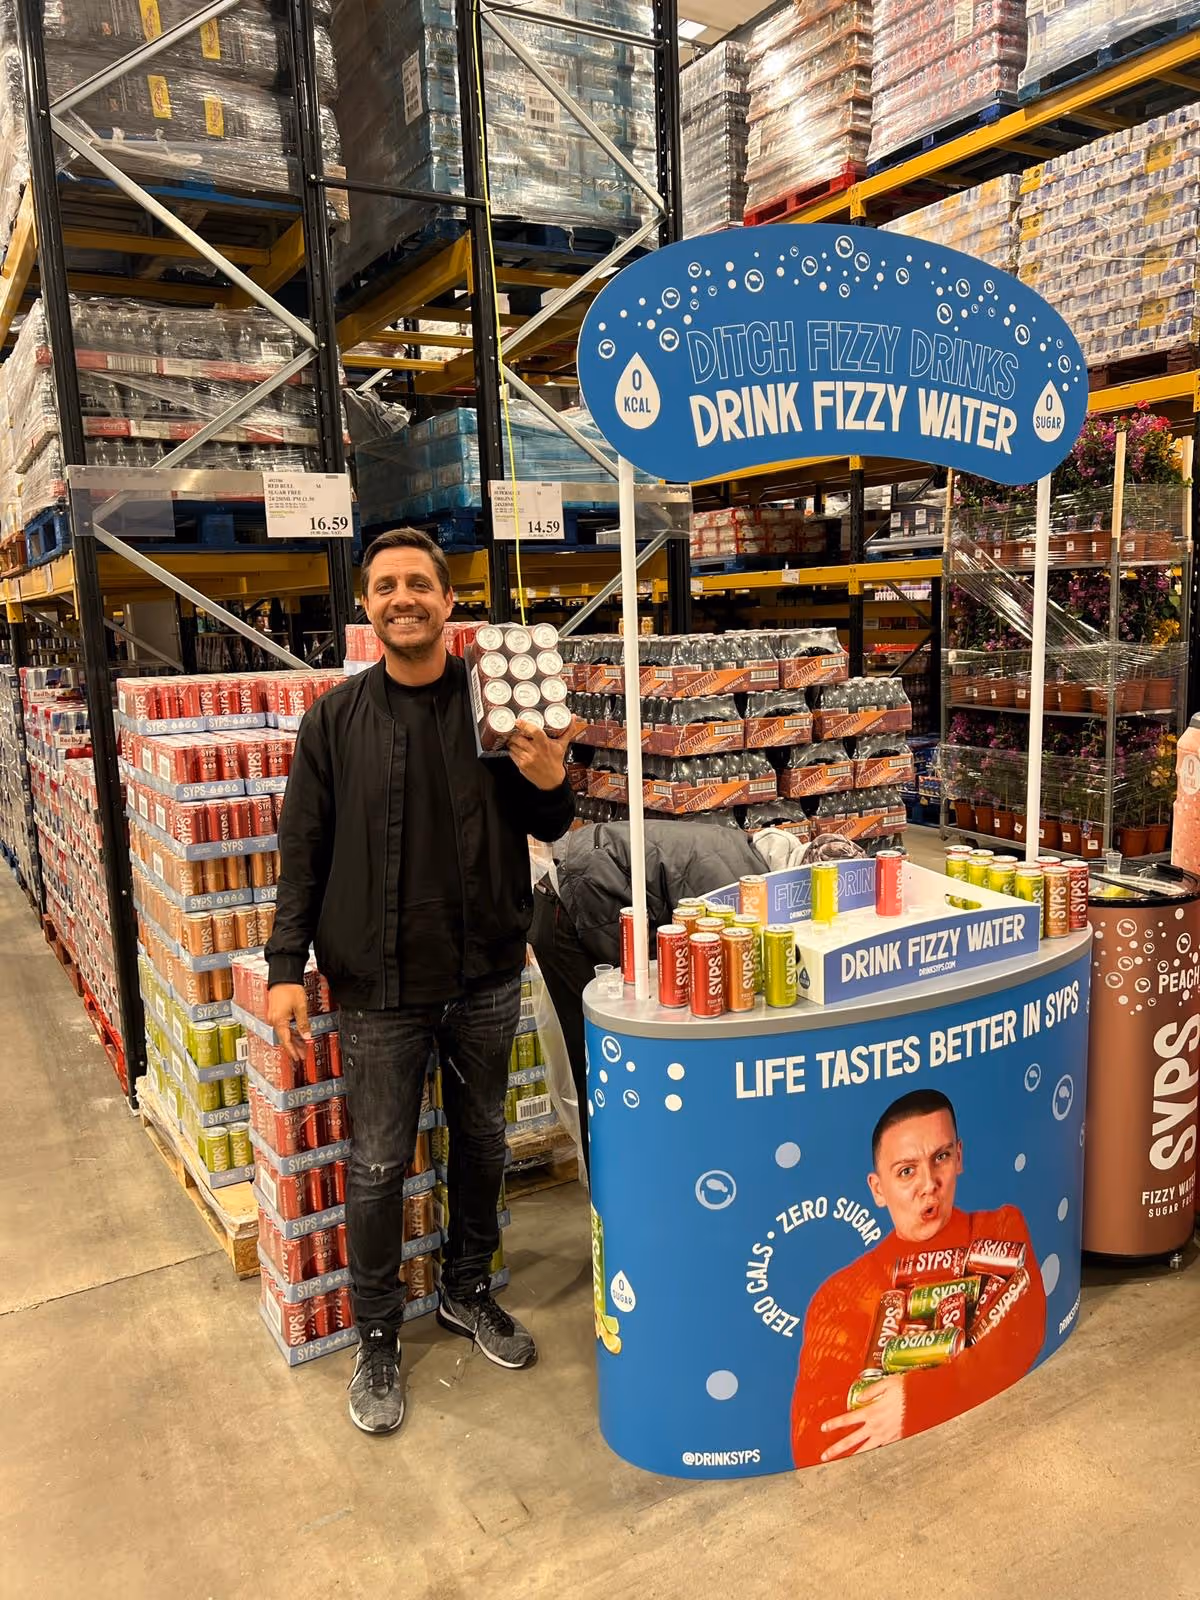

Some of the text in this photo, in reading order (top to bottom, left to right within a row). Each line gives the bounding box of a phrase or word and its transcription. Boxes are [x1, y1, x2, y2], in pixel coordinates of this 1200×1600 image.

[686, 320, 1019, 400] DITCH FIZZY DRINKS
[632, 369, 642, 391] 0
[624, 396, 651, 413] KCAL
[1045, 394, 1053, 411] 0
[689, 381, 1017, 455] DRINK FIZZY WATER
[1035, 415, 1062, 430] SUGAR
[310, 516, 348, 530] 16.59
[528, 521, 560, 533] 14.59
[684, 672, 719, 696] SUPERMALT
[723, 676, 745, 692] ORIGINAL
[785, 660, 818, 688] SUPERMALT
[240, 689, 252, 713] SYPS
[145, 721, 167, 732] SYPS
[208, 717, 228, 728] SYPS
[831, 713, 861, 738] SUPERMALT
[677, 728, 711, 755] SUPERMALT
[748, 721, 781, 747] SUPERMALT
[248, 752, 262, 780] SYPS
[856, 763, 884, 787] SUPERMALT
[183, 786, 206, 798] SYPS
[255, 780, 276, 792] SYPS
[791, 770, 824, 797] SUPERMALT
[684, 786, 718, 811] SUPERMALT
[723, 789, 744, 805] ORIGINAL
[221, 841, 244, 853] SYPS
[190, 896, 212, 909] SYPS
[261, 887, 277, 899] SYP
[774, 879, 812, 911] FIZZ
[1049, 886, 1066, 919] SYPS
[1070, 880, 1087, 912] SYPS
[841, 913, 1026, 983] DRINK FIZZY WATER
[675, 946, 689, 986] SYPS
[708, 955, 722, 996] SYPS
[742, 949, 755, 989] SYPS
[785, 948, 796, 985] SYPS
[1158, 965, 1200, 995] PEACH
[197, 1005, 219, 1018] SYPS
[735, 980, 1079, 1099] LIFE TASTES BETTER IN SYPS
[509, 1072, 526, 1086] SYPS
[287, 1089, 313, 1106] SYPS
[1149, 1013, 1200, 1170] SYPS
[208, 1110, 230, 1124] SYPS
[213, 1146, 227, 1172] SYPS
[233, 1141, 247, 1168] SYPS
[288, 1155, 313, 1172] SYPS
[1141, 1186, 1175, 1205] FIZZY
[1148, 1202, 1179, 1218] SUGAR
[292, 1217, 318, 1235] SYPS
[980, 1240, 1011, 1258] SYPS
[746, 1196, 882, 1338] ZERO CALS ZERO SUGAR
[916, 1250, 953, 1272] SYPS
[297, 1279, 322, 1298] SYPS
[618, 1279, 624, 1291] 0
[612, 1289, 633, 1306] SUGAR
[289, 1313, 307, 1346] SYPS
[877, 1307, 904, 1348] SYPS
[297, 1343, 322, 1360] SYPS
[682, 1448, 761, 1466] @DRINKSYPS
